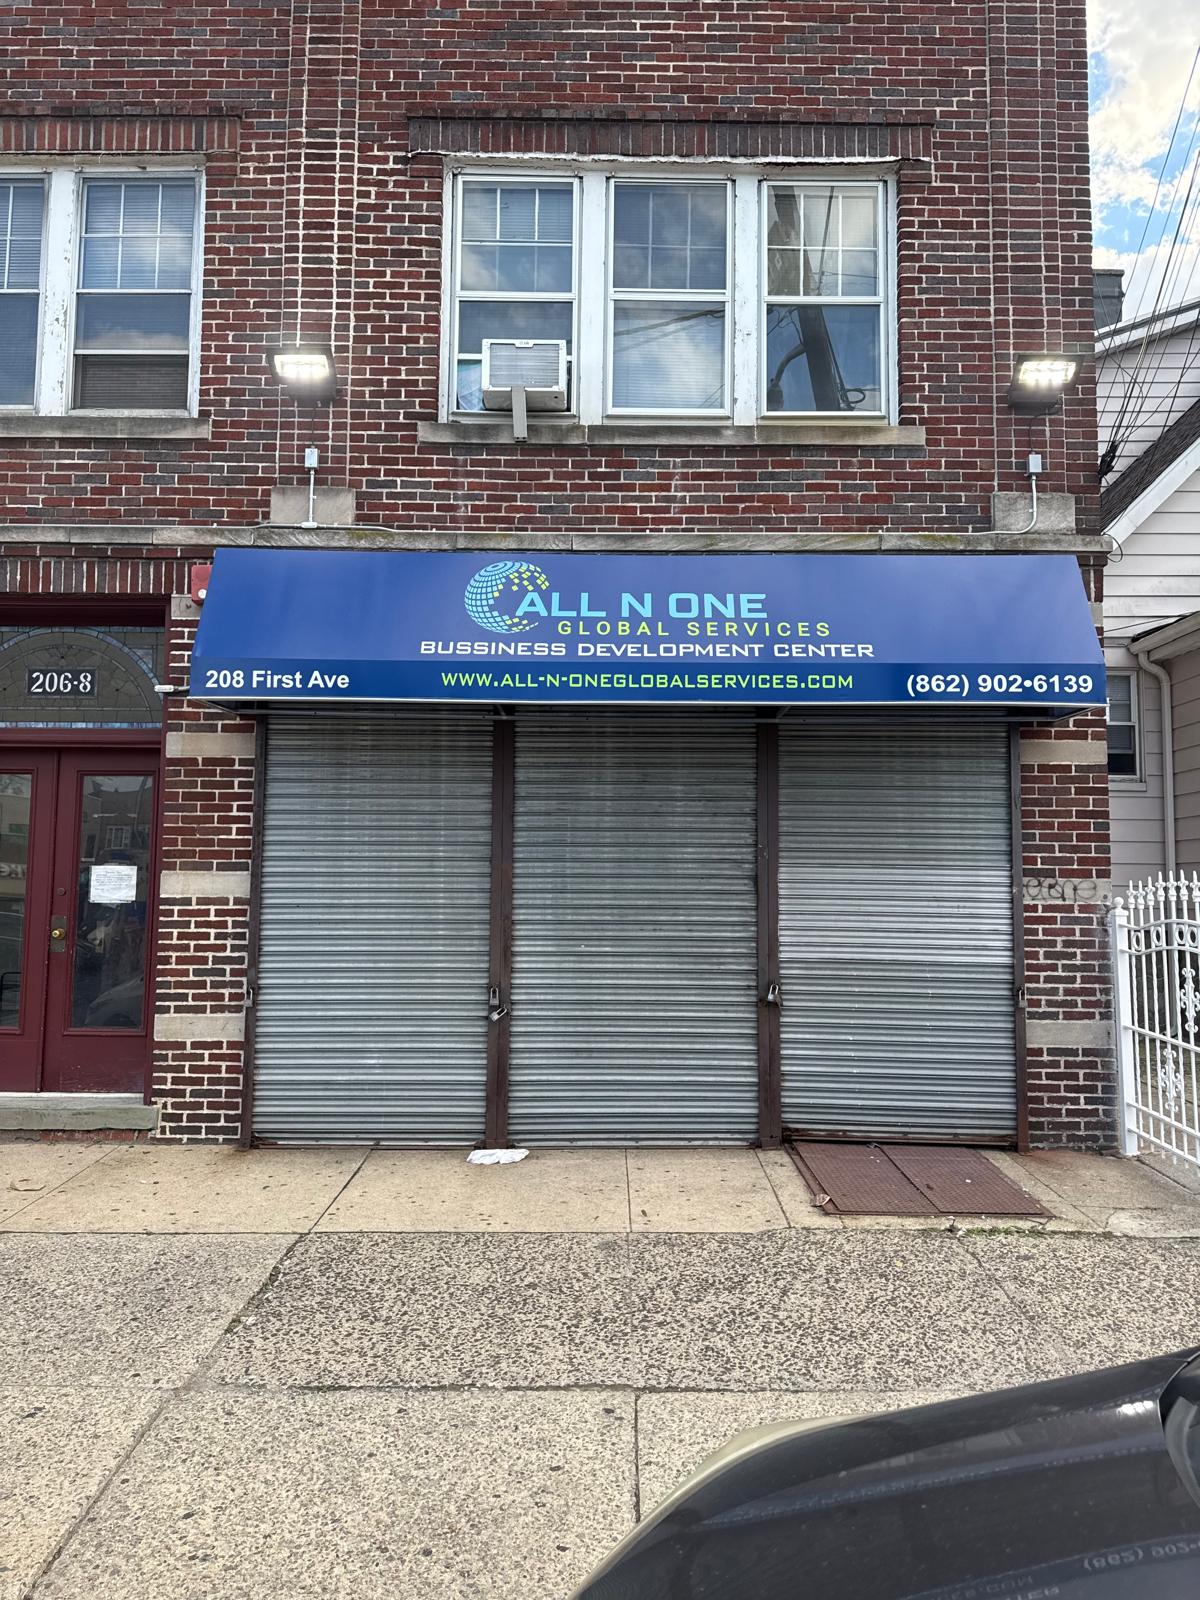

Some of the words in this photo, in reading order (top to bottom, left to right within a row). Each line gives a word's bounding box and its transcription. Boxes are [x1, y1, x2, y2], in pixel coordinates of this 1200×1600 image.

[515, 591, 606, 618] ALL
[621, 593, 652, 618] N
[669, 592, 768, 619] ONE
[557, 621, 670, 636] GLOBAL
[686, 621, 831, 637] SERVICES
[419, 640, 567, 657] BUSSINESS
[576, 642, 765, 658] DEVELOPMENT
[773, 643, 875, 658] CENTER
[31, 671, 93, 694] 206-8
[205, 670, 245, 689] 208
[251, 670, 302, 689] First
[307, 671, 350, 689] Ave
[440, 672, 854, 690] WWW.ALL-N-ONEGLOBALSERVICES.COM
[906, 674, 970, 697] (862)
